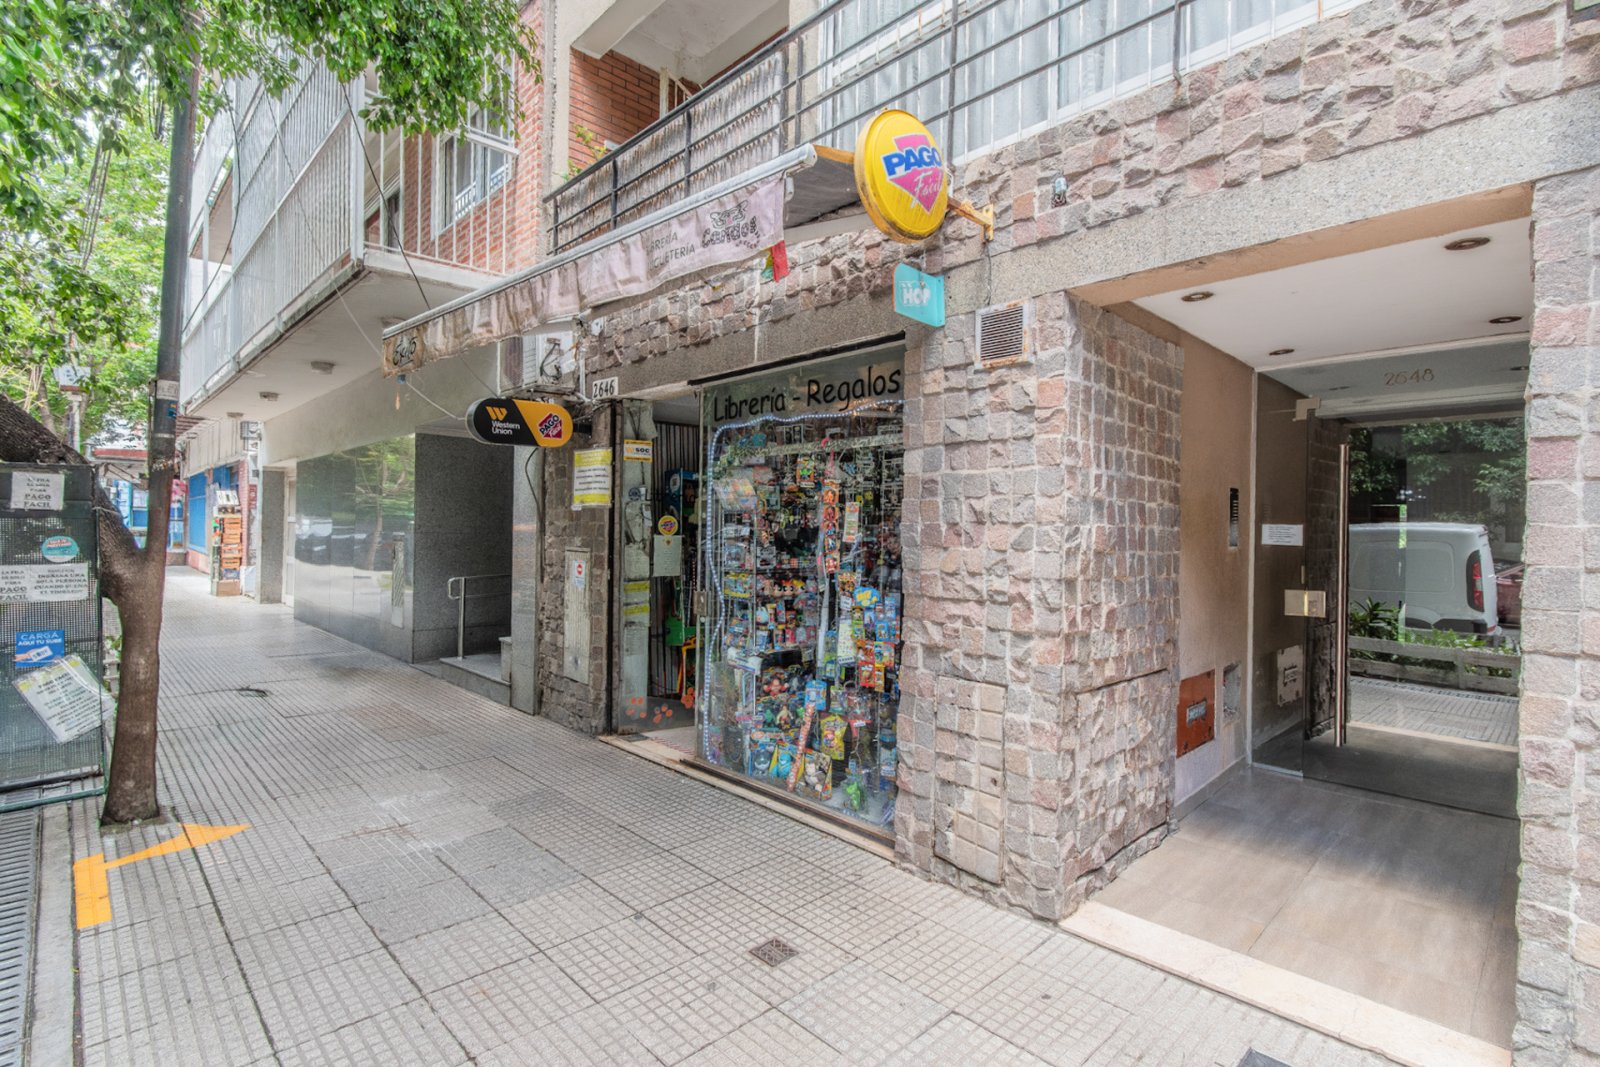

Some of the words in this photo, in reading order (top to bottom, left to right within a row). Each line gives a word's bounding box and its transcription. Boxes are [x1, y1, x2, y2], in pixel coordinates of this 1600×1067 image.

[883, 145, 942, 177] PAGO
[902, 286, 931, 305] HOP
[1383, 368, 1435, 386] 2648
[593, 379, 615, 399] 2646
[714, 387, 786, 422] Librería
[806, 366, 901, 412] Regalos
[491, 420, 521, 430] Western
[491, 427, 513, 435] Union
[539, 414, 560, 435] PAGO
